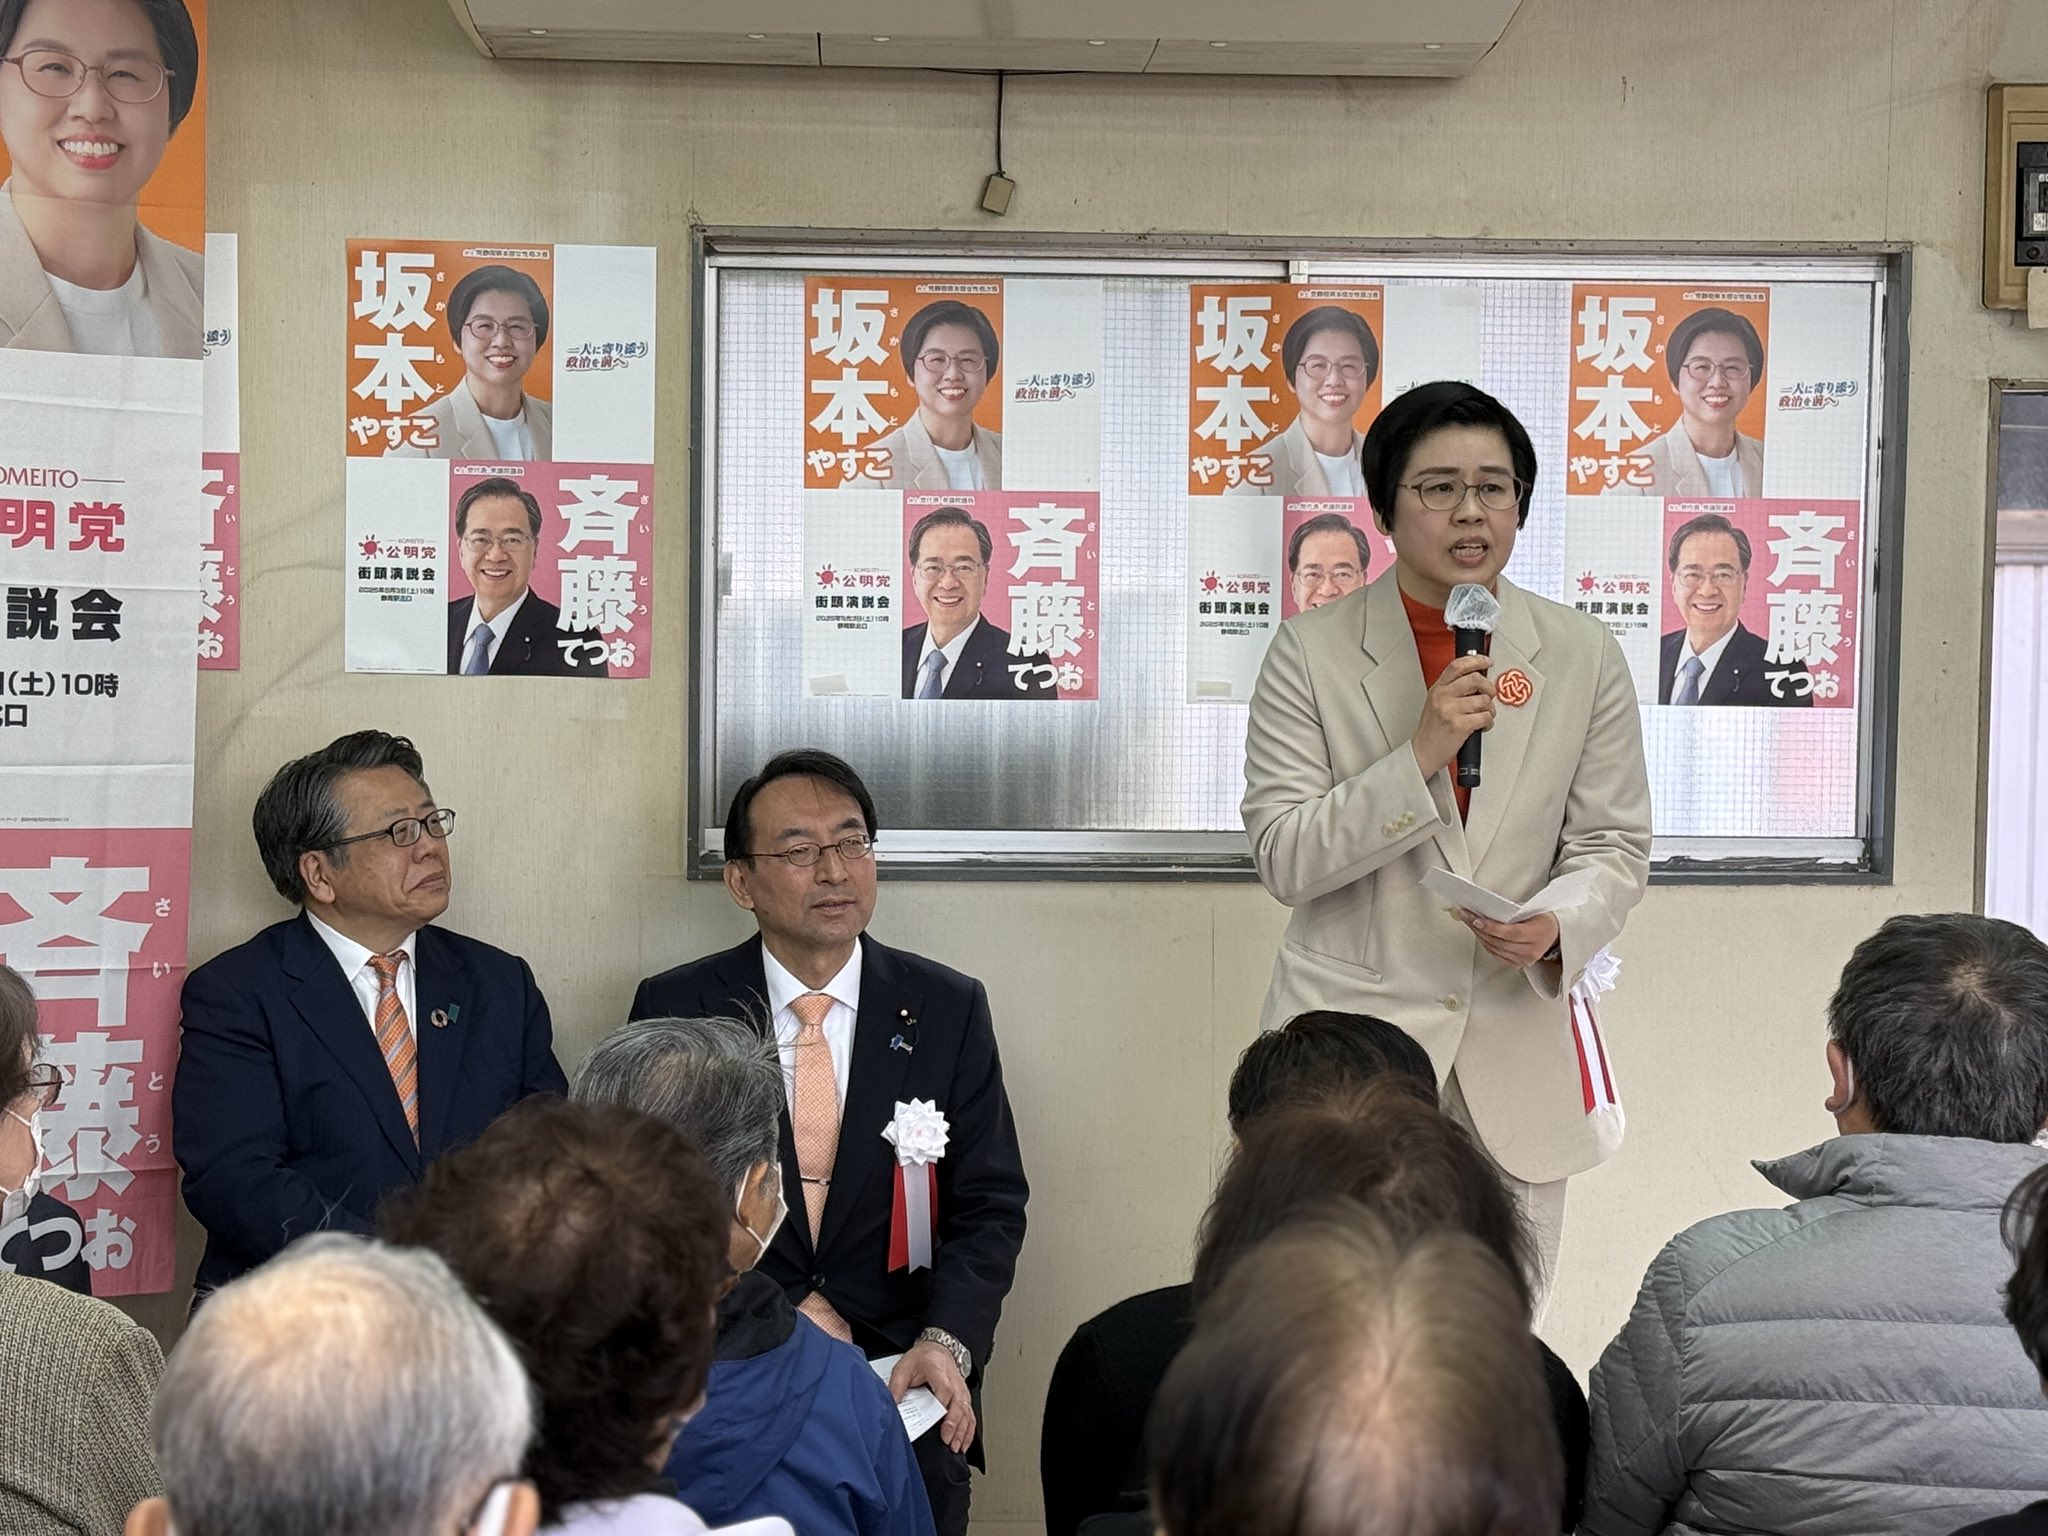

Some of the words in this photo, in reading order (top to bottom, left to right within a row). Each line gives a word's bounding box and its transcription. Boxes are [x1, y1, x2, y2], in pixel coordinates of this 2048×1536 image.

[352, 250, 436, 413] 坂本
[567, 341, 648, 358] 一人に寄り添う
[565, 356, 627, 370] 政治を前へ
[809, 288, 889, 445] 坂本
[1194, 295, 1273, 452] 坂本
[1573, 295, 1656, 452] 坂本
[1016, 373, 1095, 388] 一人に寄り添う
[1780, 381, 1858, 396] 一人に寄り添う
[1015, 387, 1075, 401] 政治を前へ
[350, 415, 438, 448] やすこ
[806, 448, 891, 479] やすこ
[1192, 455, 1273, 485] やすこ
[1570, 455, 1654, 486] やすこ
[386, 545, 436, 559] 公明党
[358, 566, 435, 581] 街頭演説会
[843, 574, 891, 588] 公明党
[1226, 581, 1271, 594] 公明党
[1602, 581, 1650, 594] 公明党
[7, 587, 123, 642] 説会
[815, 595, 890, 609] 街頭演説会
[1199, 602, 1270, 615] 街頭演説会
[557, 638, 636, 667] てつお
[0, 671, 119, 698] (土)10時
[1008, 662, 1084, 691] てつお
[1764, 669, 1839, 699] てつお
[0, 704, 27, 727] 口
